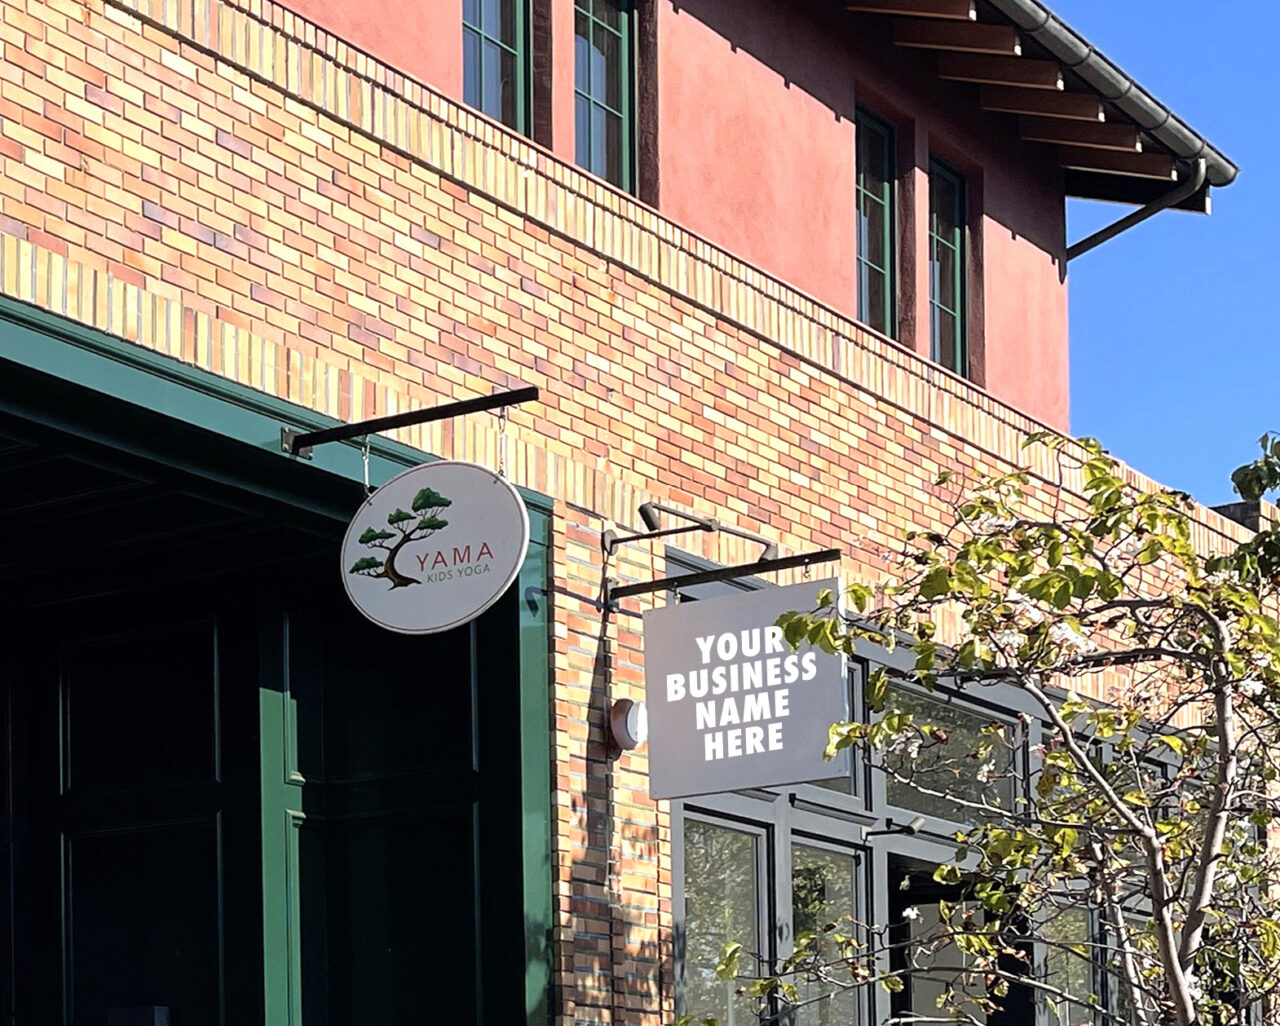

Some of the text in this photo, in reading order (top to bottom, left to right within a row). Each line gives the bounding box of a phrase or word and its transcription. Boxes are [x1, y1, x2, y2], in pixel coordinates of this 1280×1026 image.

[415, 542, 494, 572] YAMA
[427, 564, 491, 584] KIDS YOGA
[695, 625, 785, 665] YOUR
[666, 651, 817, 703] BUSINESS
[695, 688, 790, 730] NAME
[704, 721, 784, 761] HERE
